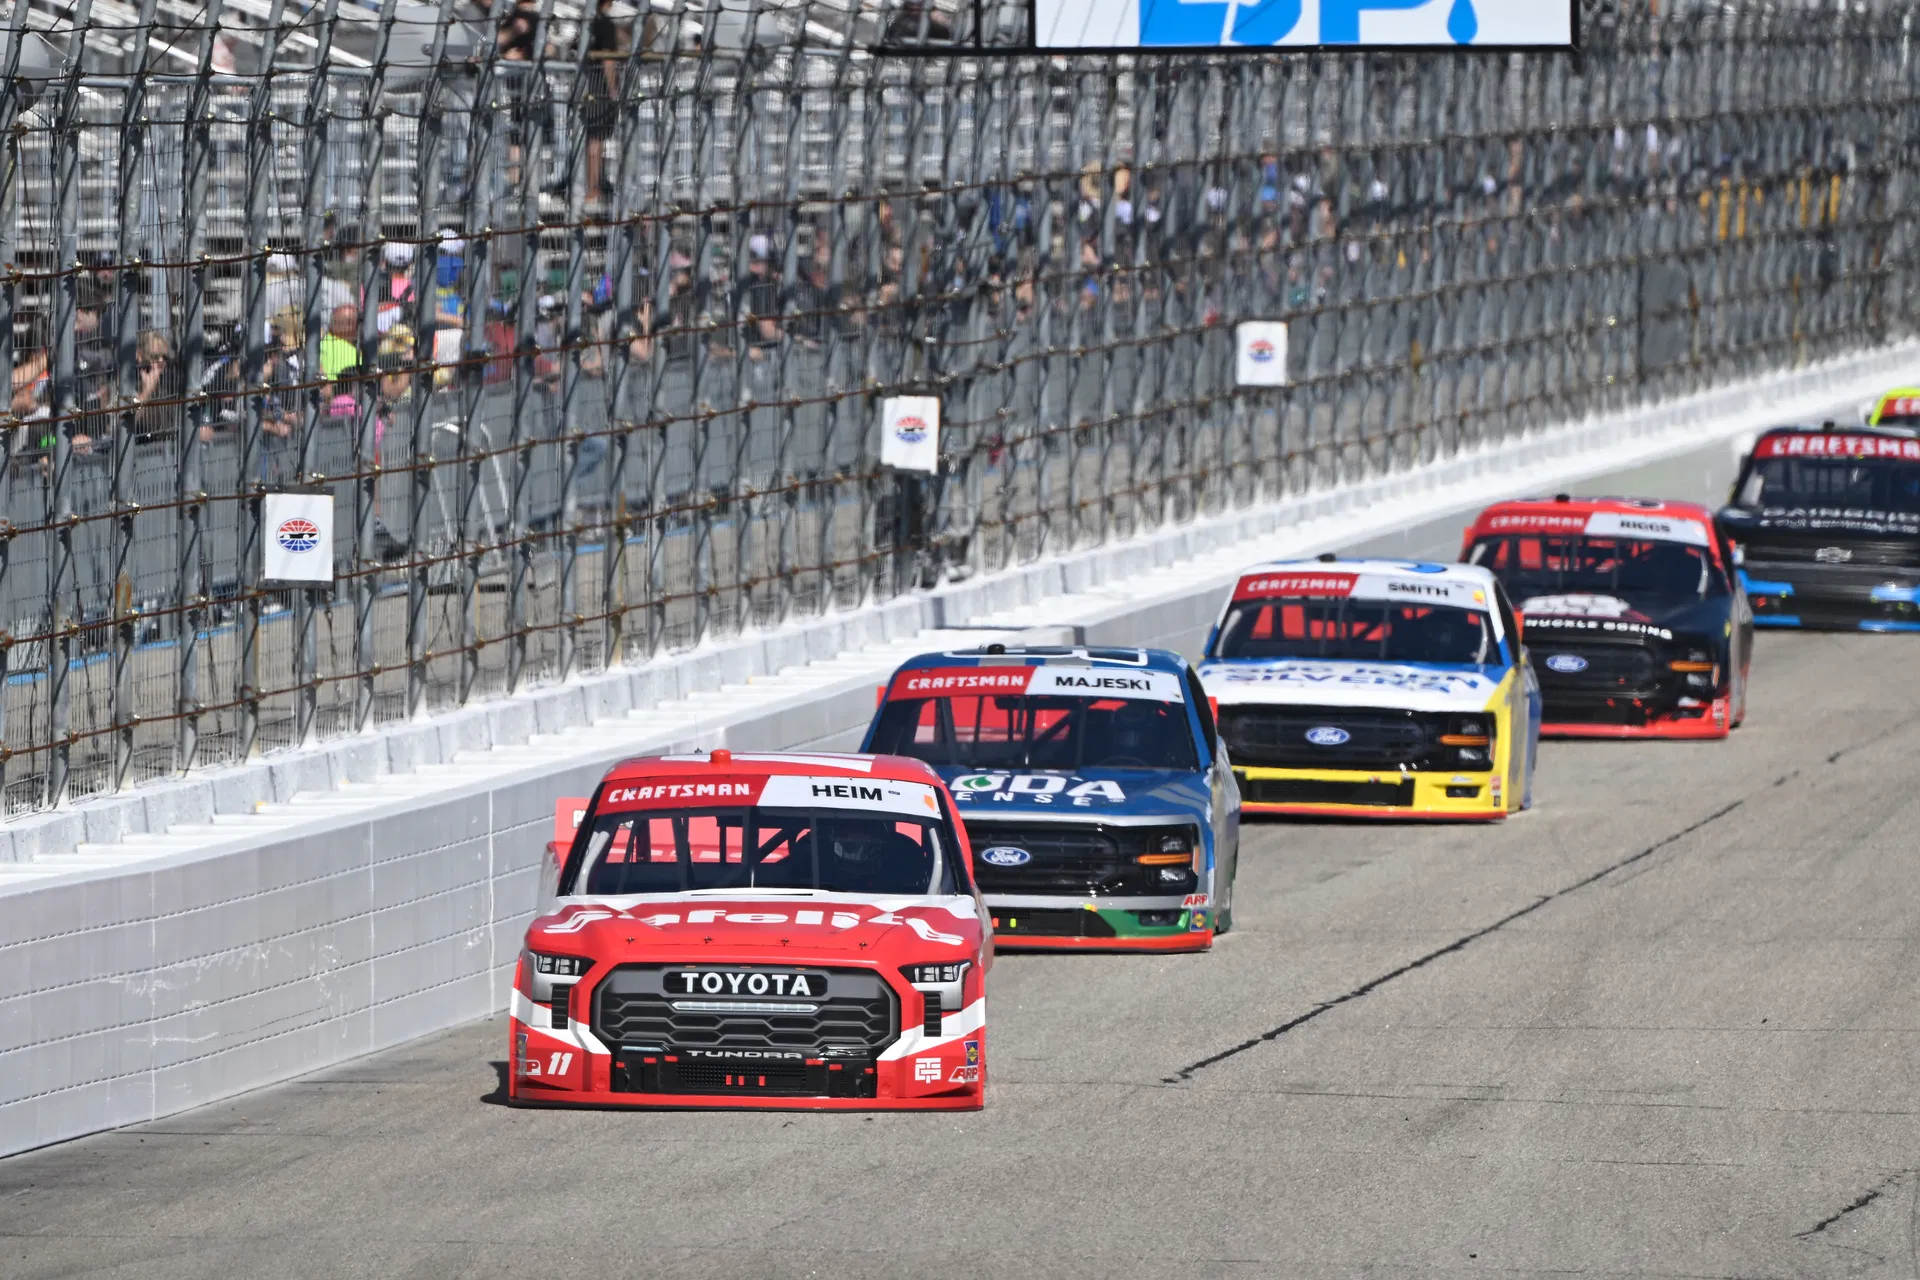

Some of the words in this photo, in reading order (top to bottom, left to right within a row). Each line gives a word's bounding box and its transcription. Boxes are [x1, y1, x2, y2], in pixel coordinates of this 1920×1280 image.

[1772, 436, 1920, 458] CRAFTSMA
[1490, 515, 1584, 528] CRAFTSMAN
[1247, 578, 1350, 592] CRAFTSMAN
[1388, 582, 1449, 596] SMITH
[1525, 619, 1599, 629] NUCKLE
[907, 675, 1024, 690] CRAFTSMAN
[1055, 676, 1151, 691] MAJESKI
[1310, 729, 1345, 743] Ford
[608, 783, 750, 803] CRAFTSMAN
[811, 784, 883, 801] HEIM
[948, 771, 1126, 802] ODA
[955, 791, 1093, 807] ENSE
[987, 848, 1025, 865] Ford
[681, 972, 811, 996] TOYOTA
[686, 1050, 802, 1059] TUNDRA
[547, 1052, 573, 1076] 11
[949, 1066, 979, 1082] ARP
